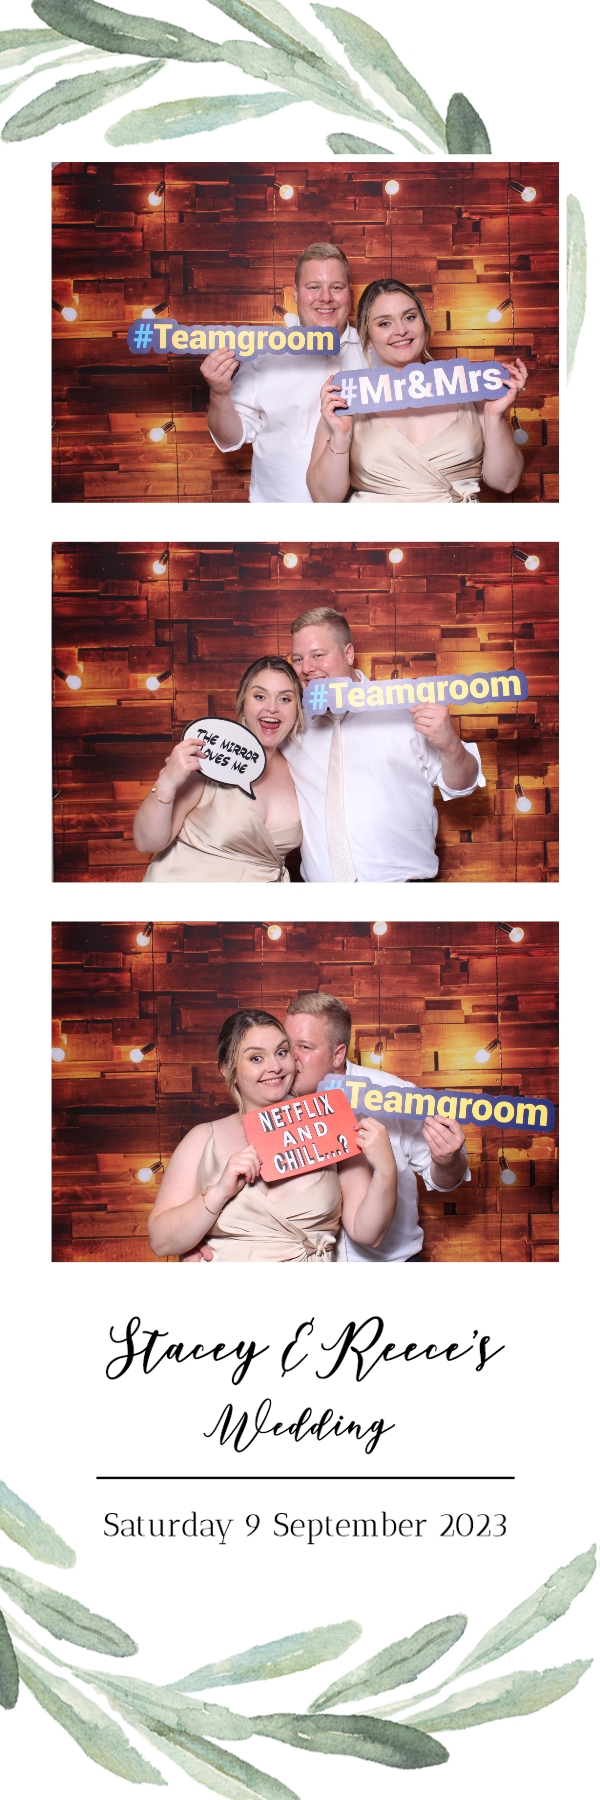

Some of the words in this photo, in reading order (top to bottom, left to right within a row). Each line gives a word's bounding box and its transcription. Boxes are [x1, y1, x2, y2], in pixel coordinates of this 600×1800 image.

[134, 323, 334, 357] #Teamgroom
[340, 365, 503, 407] #Mr&Mrs
[309, 675, 522, 711] #Teamgroom
[197, 728, 219, 746] THE
[219, 739, 260, 764] MIRROR
[231, 760, 248, 774] ME
[258, 1094, 335, 1133] NETFLIX
[283, 1121, 328, 1148] AND
[273, 1134, 350, 1174] CHILL...?
